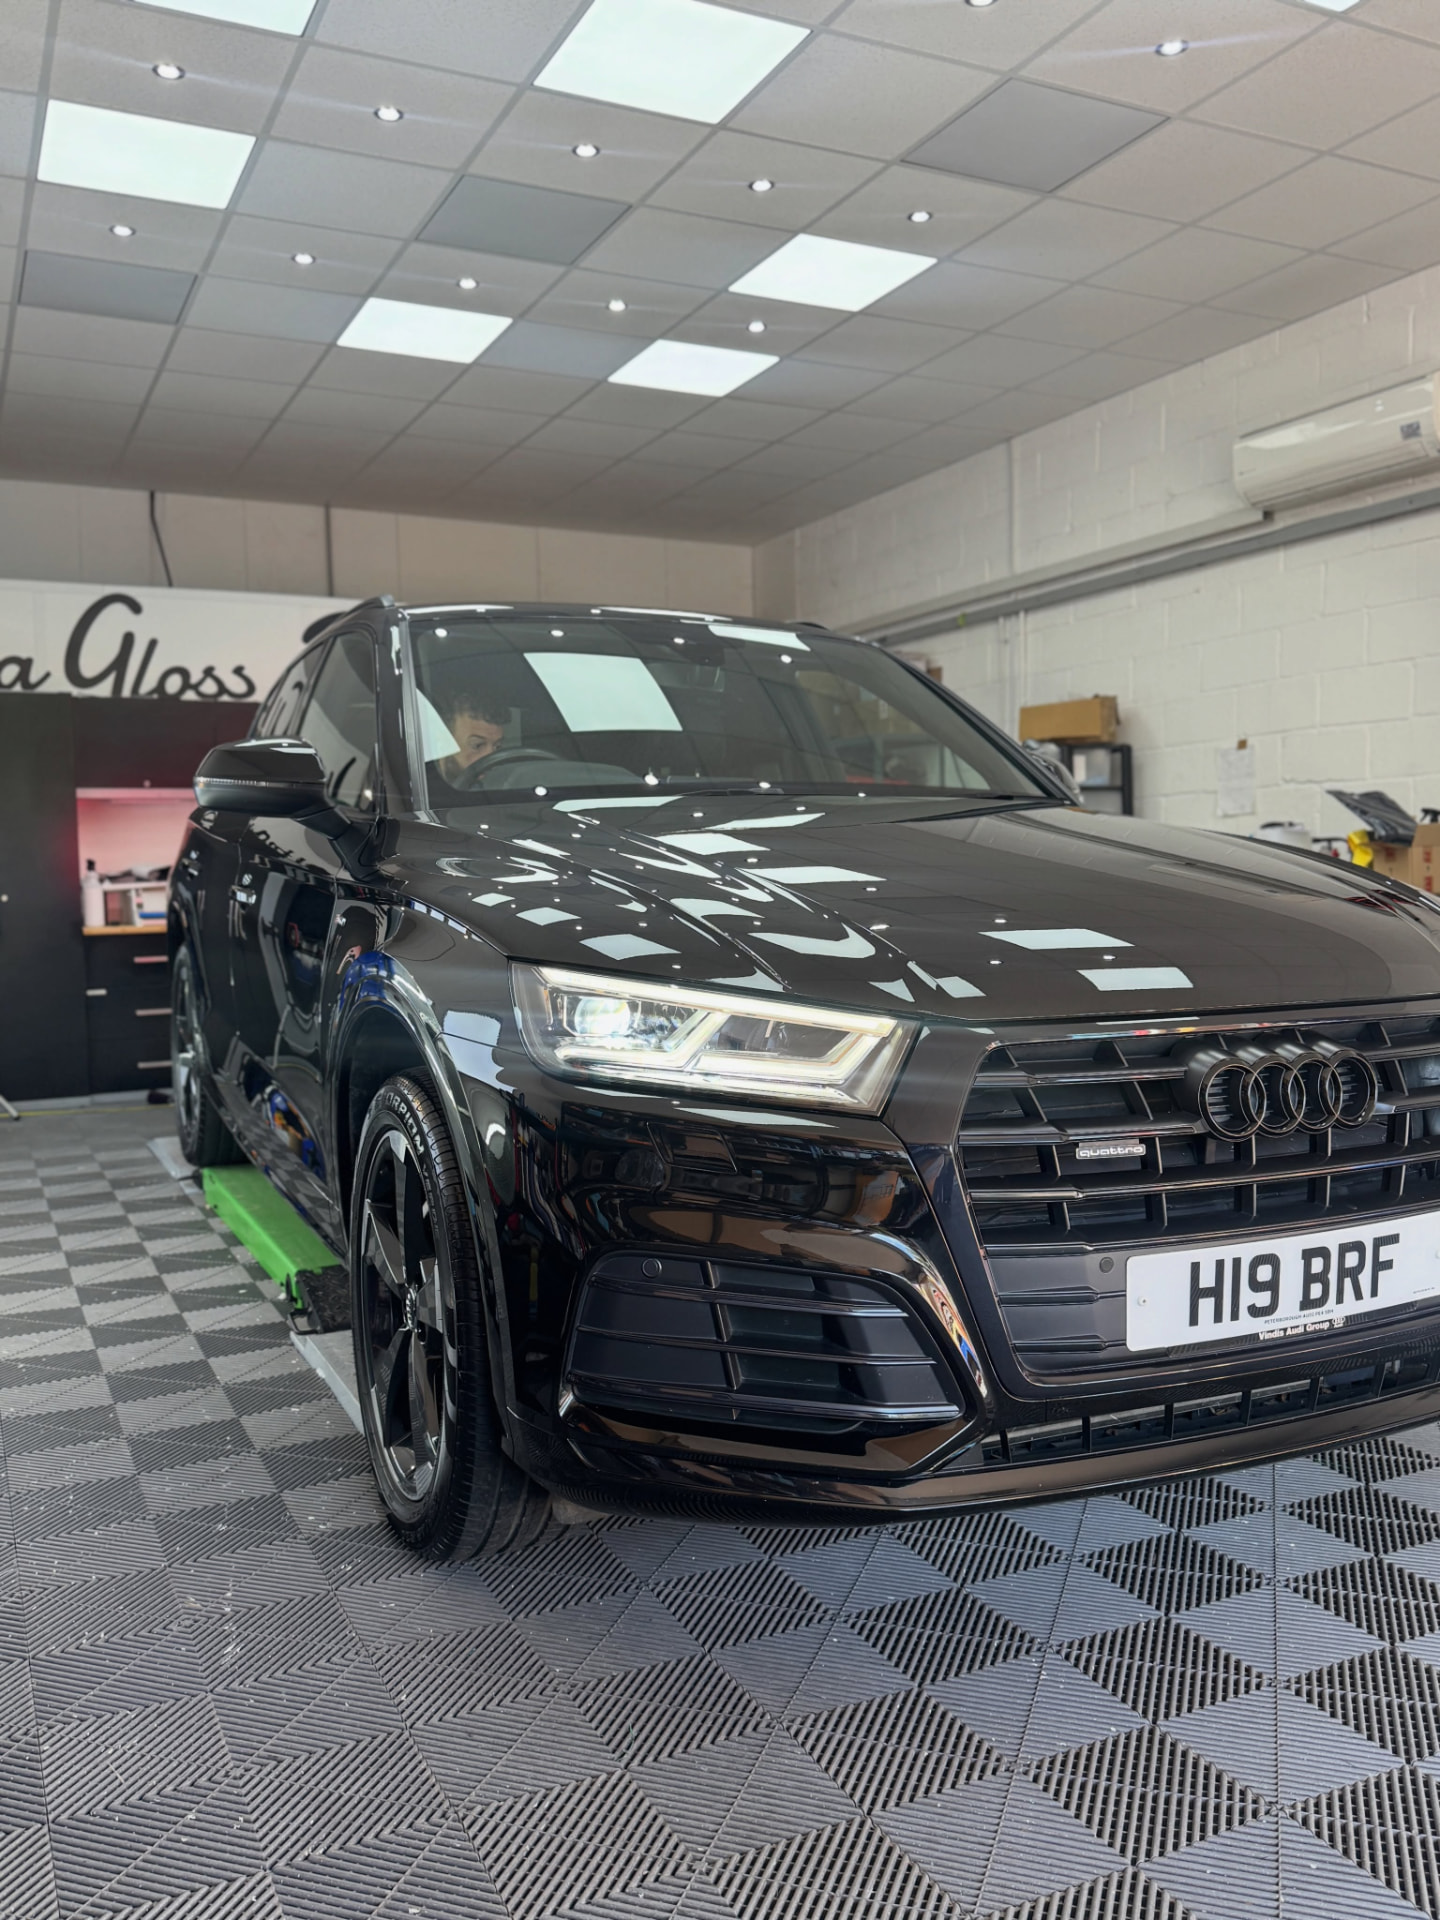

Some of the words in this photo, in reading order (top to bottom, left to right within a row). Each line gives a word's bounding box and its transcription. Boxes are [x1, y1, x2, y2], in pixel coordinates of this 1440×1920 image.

[64, 592, 256, 701] Gloss
[1079, 1146, 1144, 1158] quattro
[1188, 1252, 1282, 1328] H19
[1298, 1232, 1400, 1312] BRF
[1258, 1329, 1285, 1340] Vindis
[1286, 1325, 1304, 1336] Audi
[1306, 1320, 1330, 1331] Group
